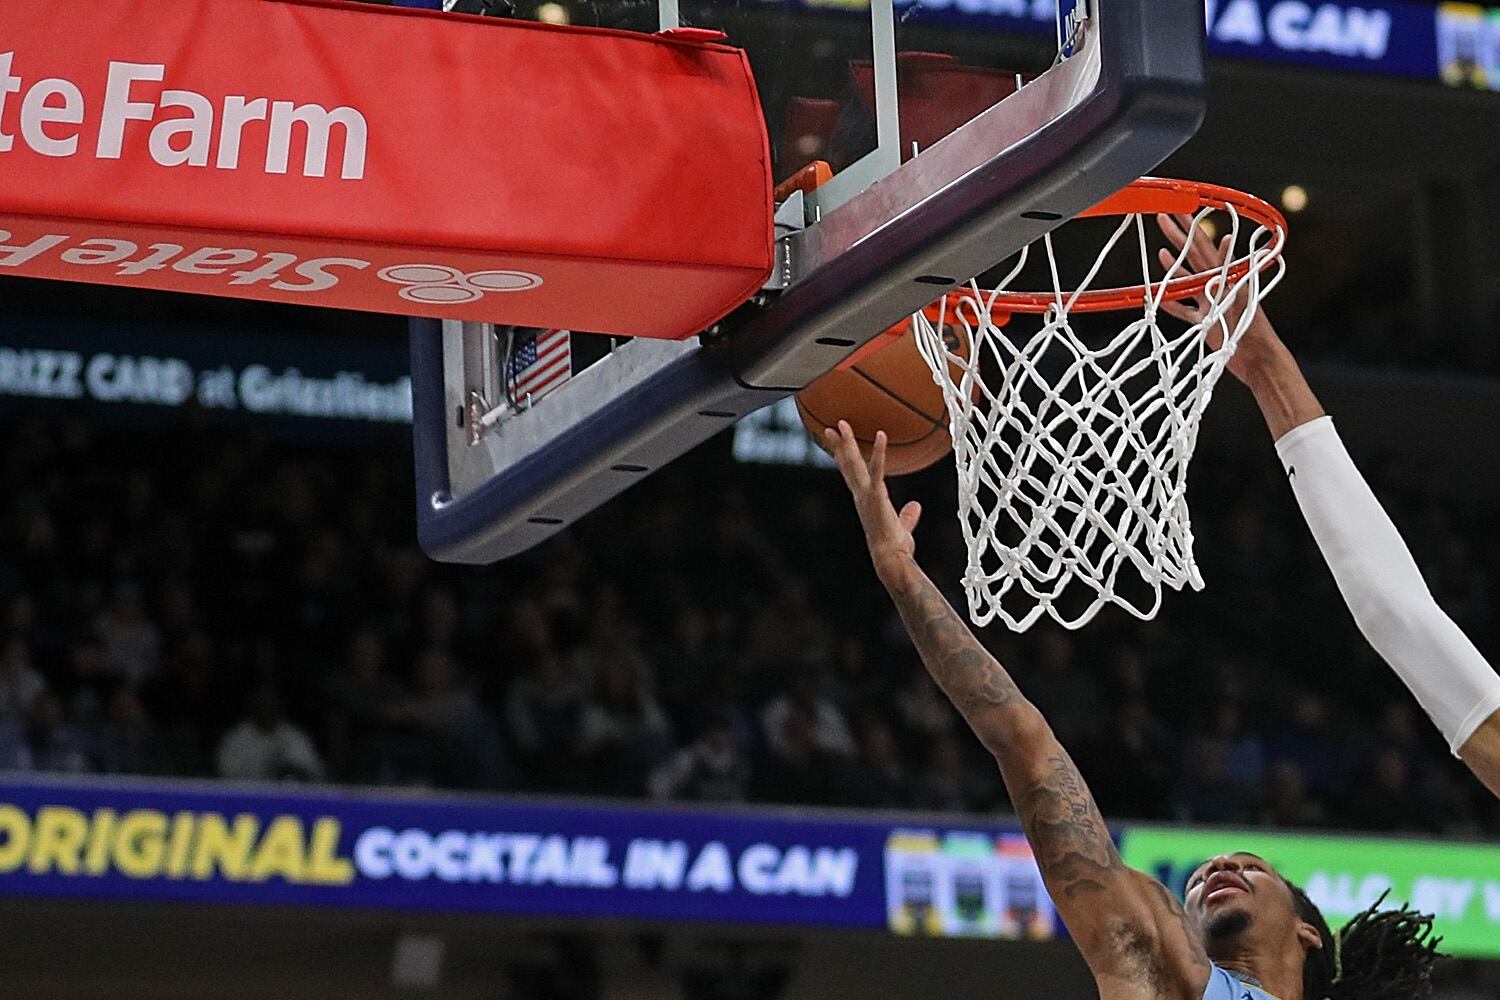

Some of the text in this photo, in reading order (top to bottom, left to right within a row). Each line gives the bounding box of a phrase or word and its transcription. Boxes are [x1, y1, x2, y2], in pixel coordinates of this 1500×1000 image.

[1266, 0, 1392, 60] CAN
[0, 229, 371, 292] StateF
[354, 826, 618, 889] COCKTAIL
[622, 837, 688, 891] IN
[687, 841, 733, 892] A
[737, 843, 858, 898] CAN
